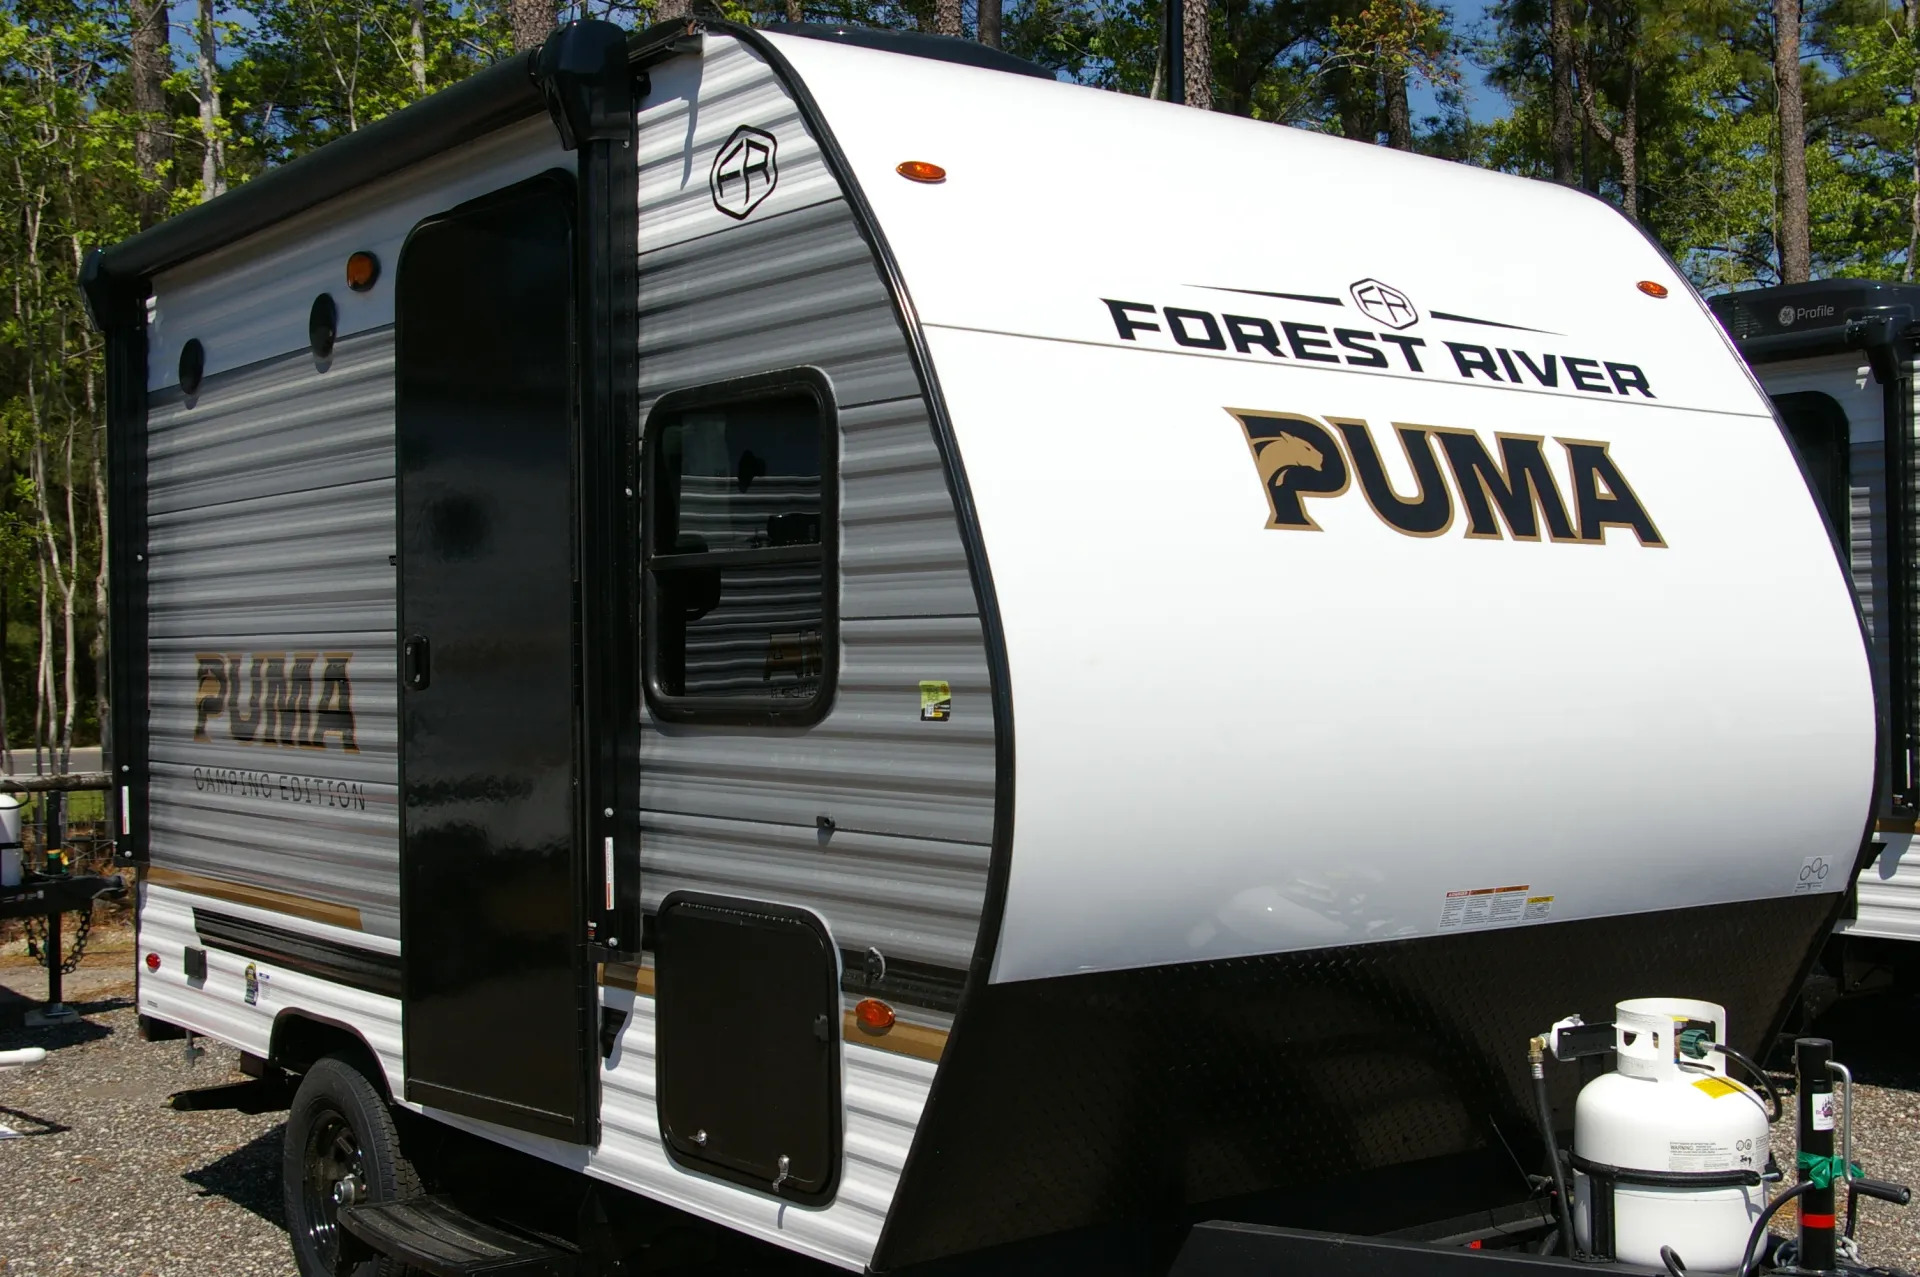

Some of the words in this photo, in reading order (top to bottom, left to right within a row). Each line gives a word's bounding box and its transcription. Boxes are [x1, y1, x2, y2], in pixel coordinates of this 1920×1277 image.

[1099, 297, 1427, 372] FOREST
[1442, 340, 1657, 398] RIVER
[1797, 304, 1834, 320] Profile
[1221, 406, 1669, 549] PUMA
[193, 652, 360, 755] PUMA
[193, 767, 272, 798] CAMPING
[279, 776, 366, 811] EDITION
